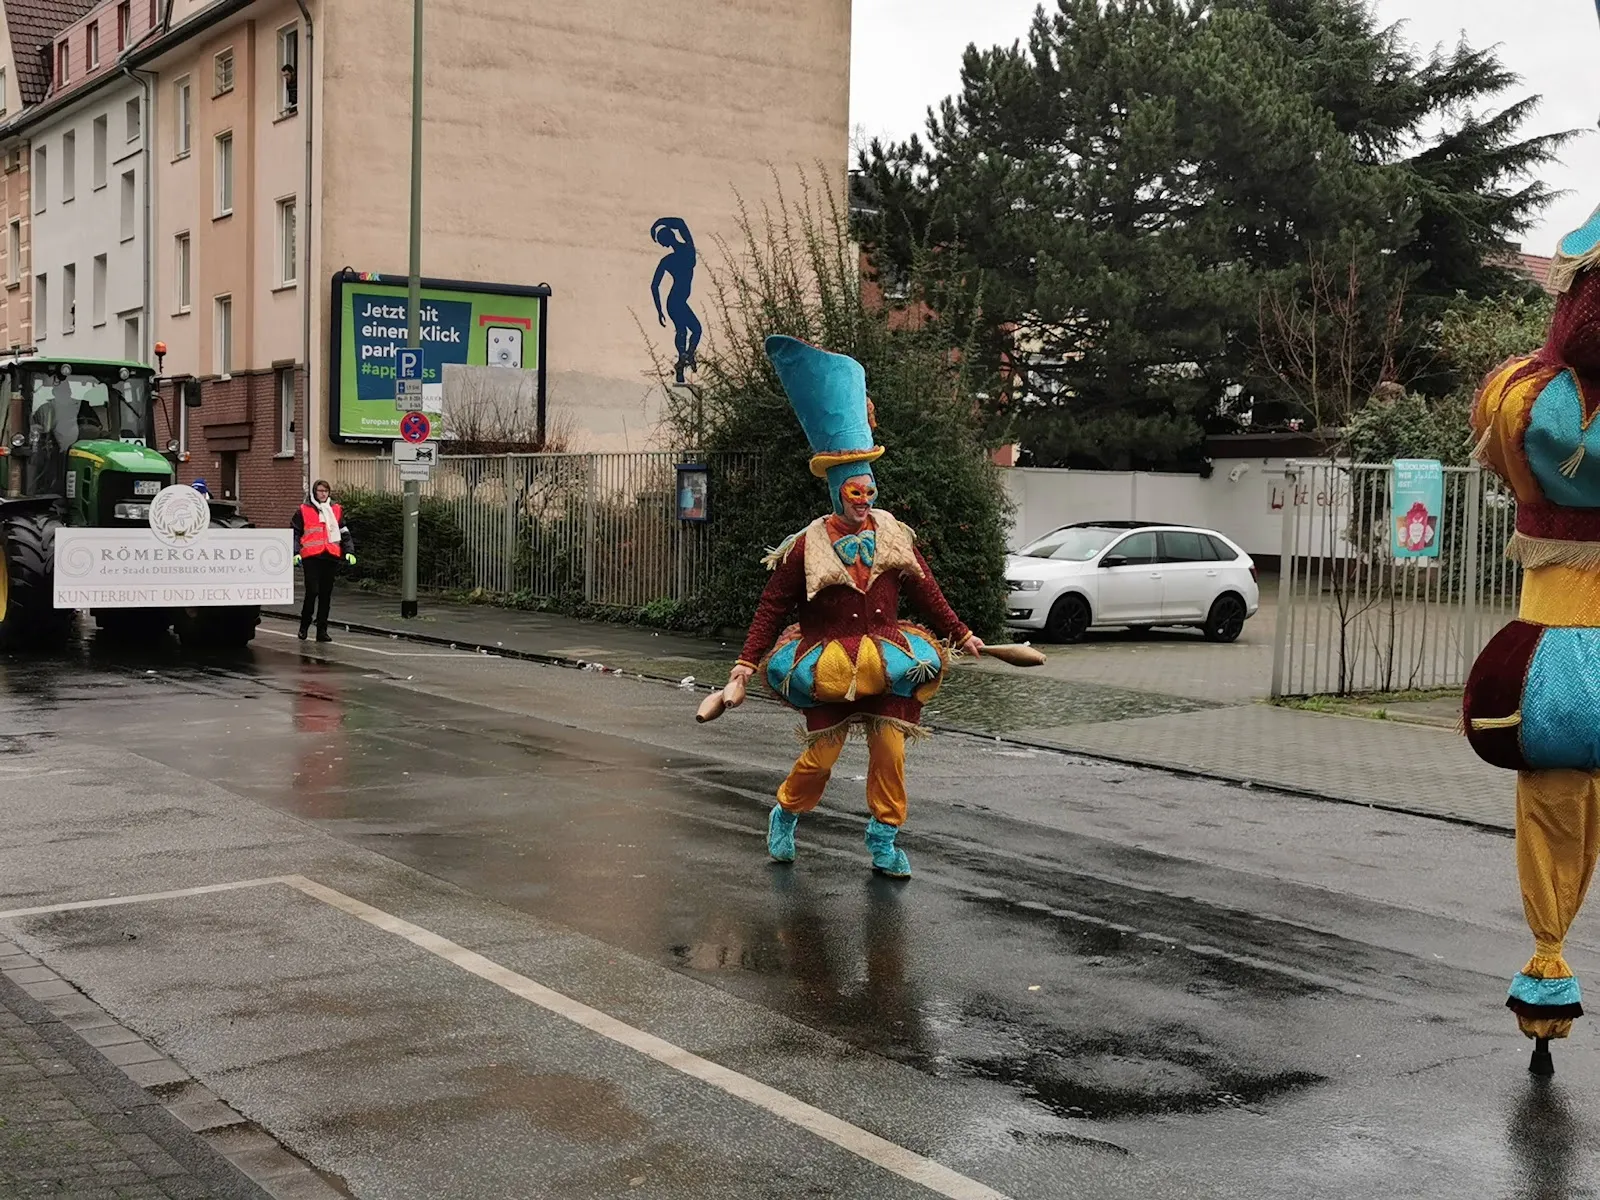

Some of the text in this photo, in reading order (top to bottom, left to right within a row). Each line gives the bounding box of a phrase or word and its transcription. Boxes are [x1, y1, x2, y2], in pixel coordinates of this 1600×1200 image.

[362, 303, 406, 320] Jetzt
[419, 325, 460, 343] Klick
[402, 353, 417, 377] P
[361, 418, 389, 431] Europas
[100, 546, 255, 561] RÖMERGARDE
[100, 566, 119, 574] der
[122, 566, 150, 574] Stadt
[152, 566, 206, 574] DUISBURG
[58, 588, 292, 602] KUNTERBUNT UND JECK VEREINT
